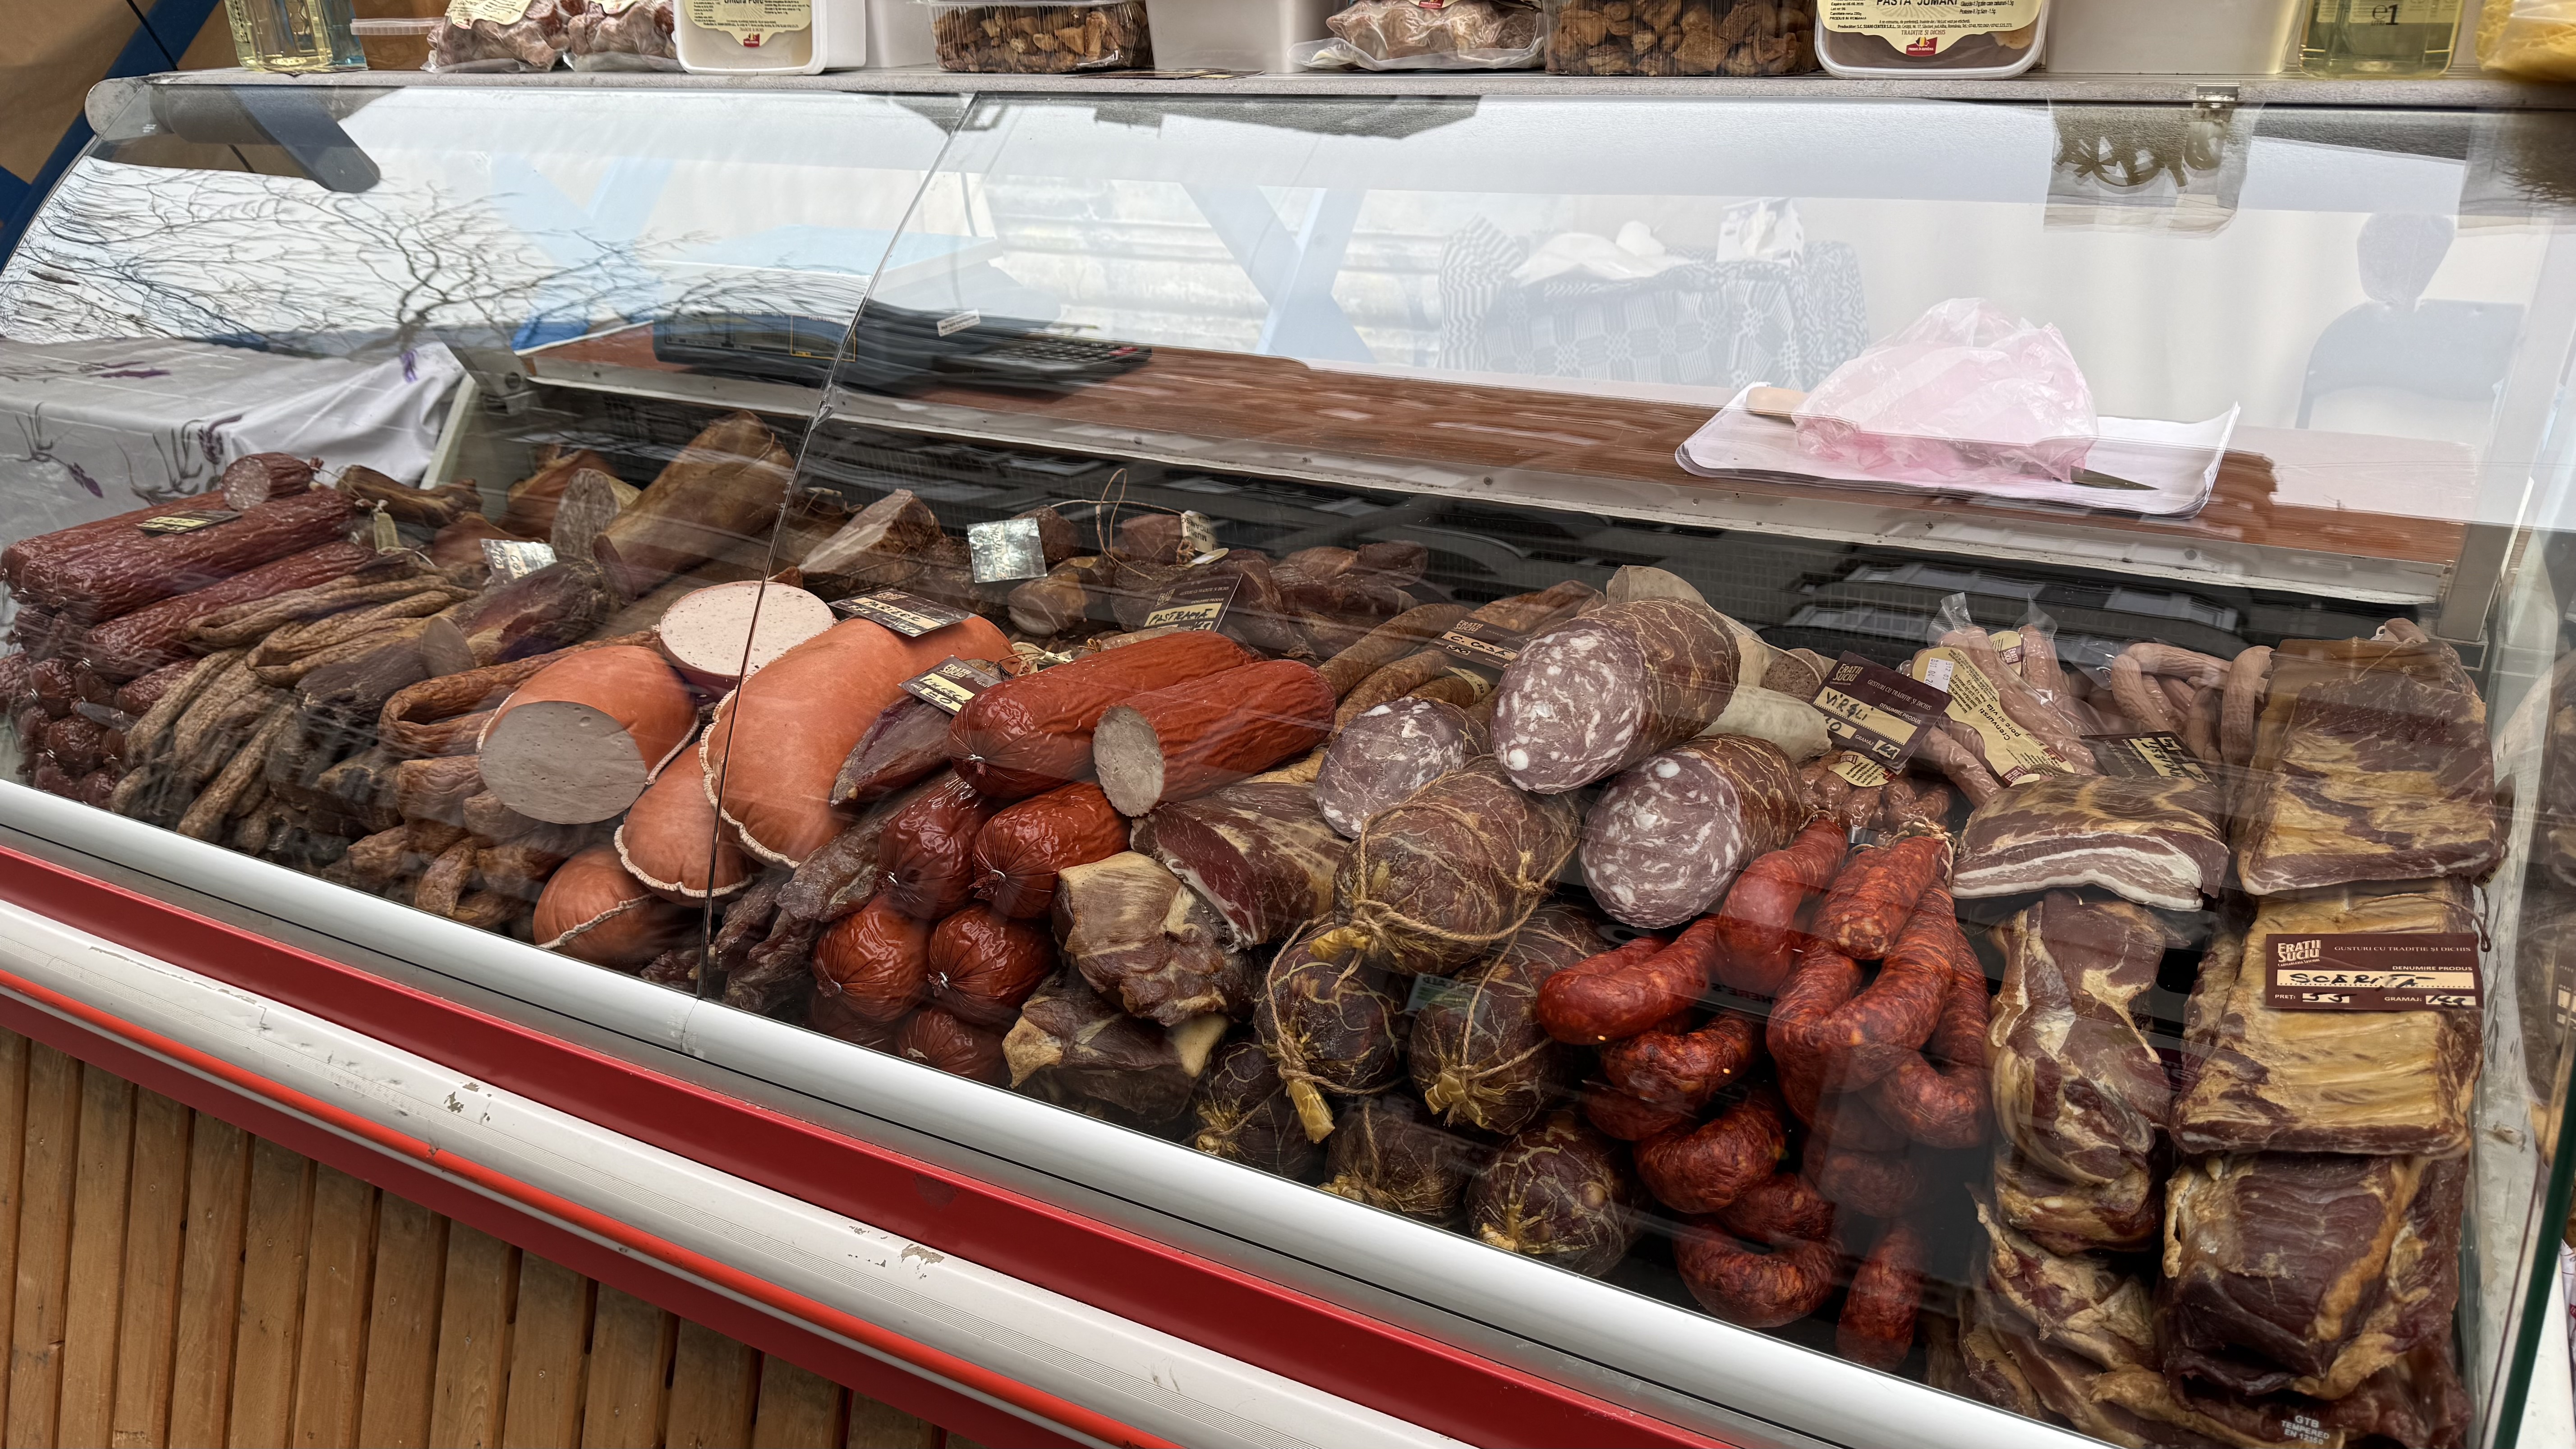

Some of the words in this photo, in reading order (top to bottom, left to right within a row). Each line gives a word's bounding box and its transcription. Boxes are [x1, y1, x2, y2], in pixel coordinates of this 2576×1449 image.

[1838, 663, 1863, 675] FRATII
[1832, 672, 1858, 682] SUCIU
[1867, 679, 1886, 691] GUSTURI
[1917, 700, 1932, 711] DICHIS
[1879, 702, 1903, 717] DENUMIRE
[1902, 713, 1922, 724] PRODUS
[1987, 704, 1999, 716] vita
[1978, 708, 2010, 741] Crenvursti
[2005, 722, 2021, 737] porc
[2277, 939, 2321, 953] FRATII
[2278, 948, 2320, 963] SUCIU
[2295, 1415, 2319, 1428] GTB
[2281, 1420, 2330, 1440] TEMPERED
[2284, 1428, 2297, 1438] EN
[2299, 1433, 2324, 1445] 12150
